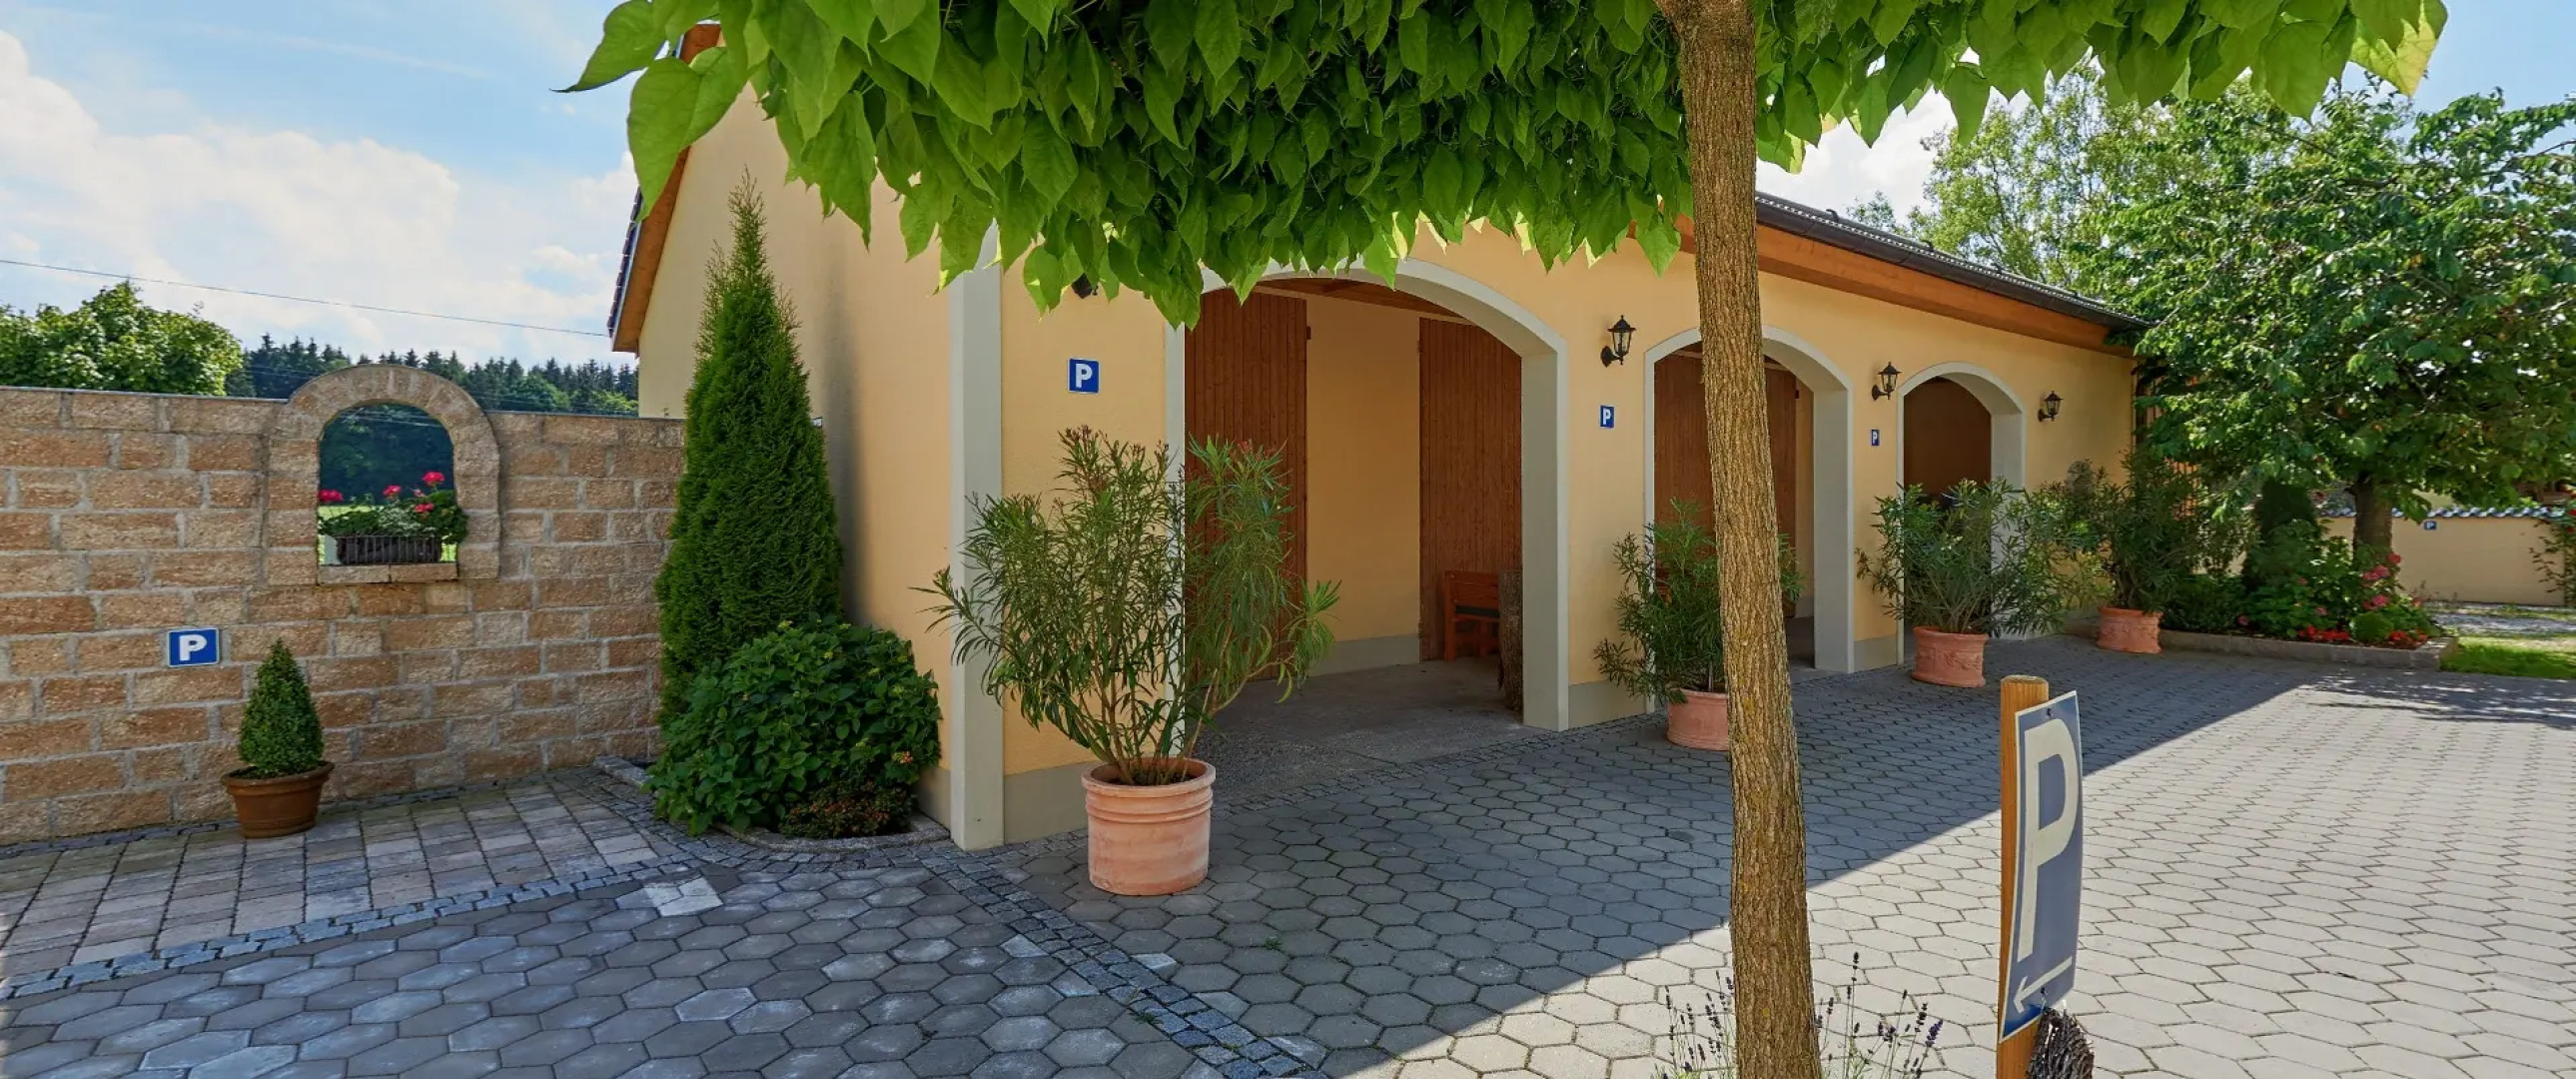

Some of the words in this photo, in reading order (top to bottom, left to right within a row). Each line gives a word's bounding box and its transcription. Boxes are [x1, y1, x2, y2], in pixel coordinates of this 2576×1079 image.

[1076, 363, 1093, 389] P
[1603, 407, 1611, 426] P
[1873, 431, 1878, 444] P
[179, 634, 208, 661] P
[2017, 718, 2080, 963] P
